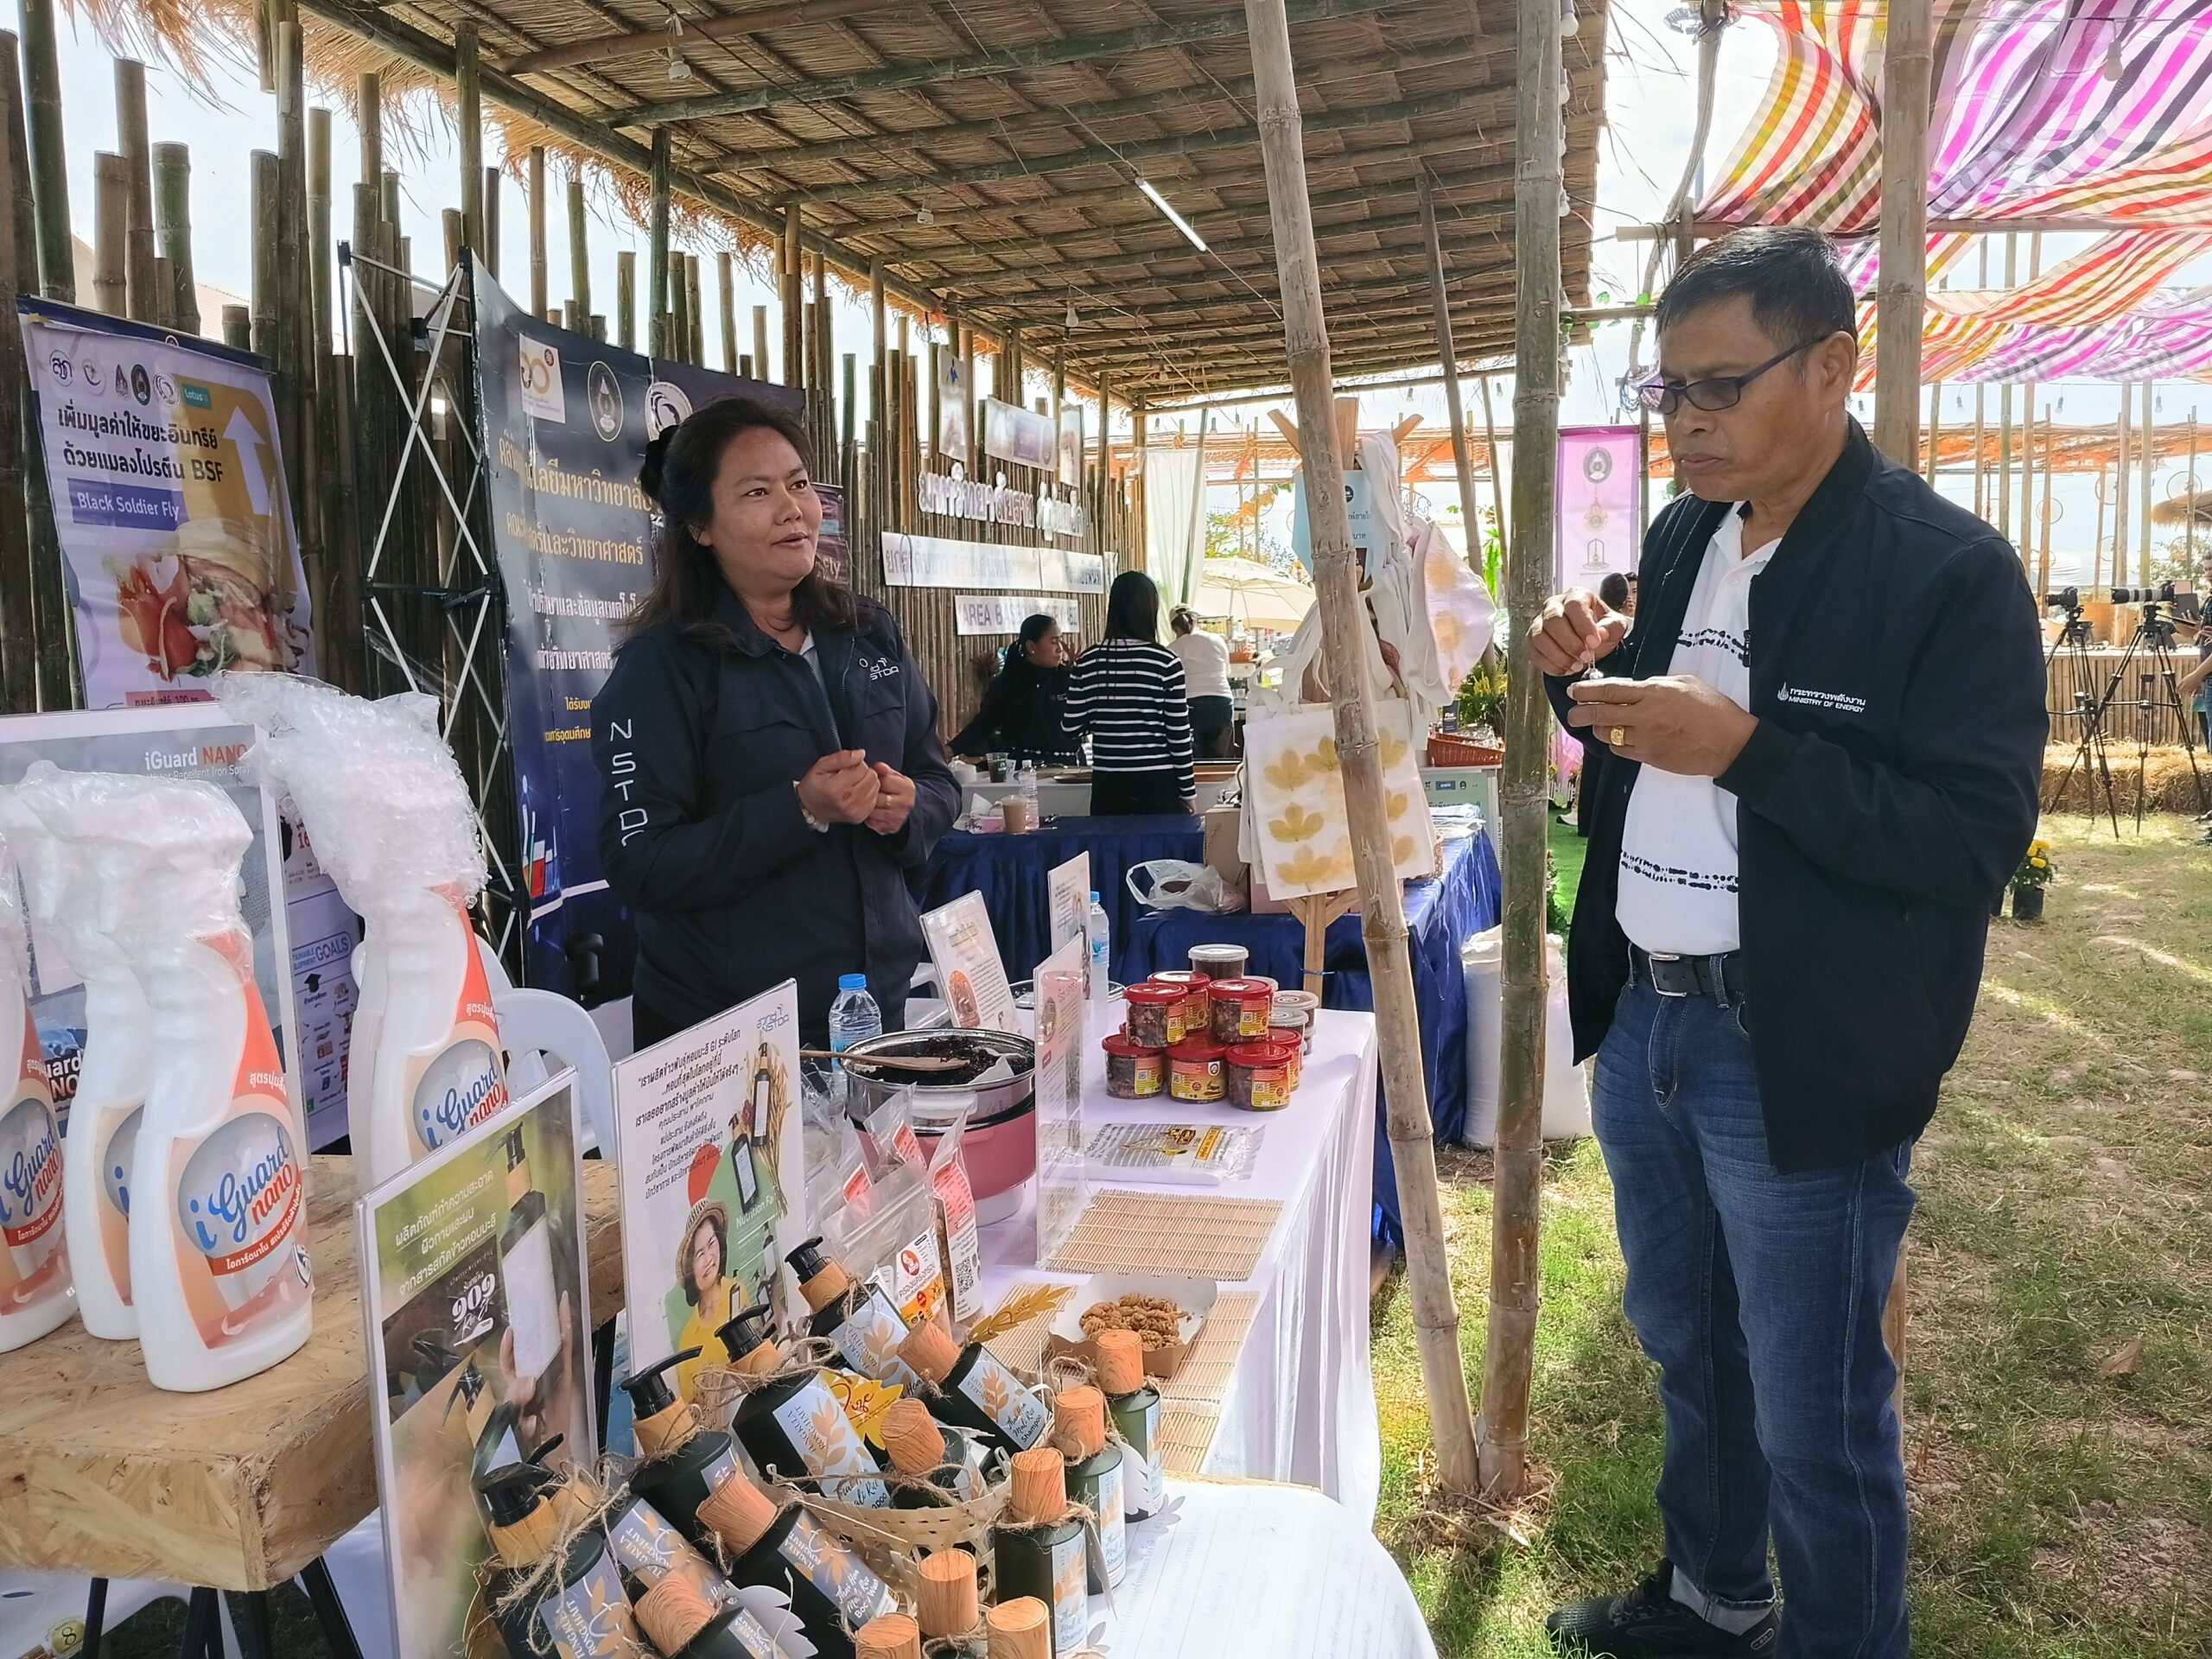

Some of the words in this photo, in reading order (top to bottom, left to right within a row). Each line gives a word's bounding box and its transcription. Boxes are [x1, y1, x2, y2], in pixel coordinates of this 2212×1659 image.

[58, 401, 219, 450] เพิ่มมูลค่าให้ขยะอินทรีย์
[64, 439, 185, 480] ด้วยแมลงโปรตีน
[193, 459, 224, 483] BSF
[77, 492, 114, 512] Black
[117, 496, 160, 517] Soldier
[162, 503, 180, 522] Fly
[870, 665, 899, 680] STDA
[1788, 696, 1822, 706] MINISTRY
[1835, 702, 1865, 714] ENERGY
[1789, 688, 1866, 706] กระทรวงพลังงาน
[144, 747, 198, 771] iGuard
[202, 742, 249, 766] NANO
[212, 766, 227, 776] Iron
[229, 765, 250, 776] Spray
[316, 935, 349, 961] GOALS
[436, 1064, 499, 1136] Guard
[469, 1083, 501, 1127] nano
[4, 1113, 56, 1217] Guard
[35, 1148, 60, 1202] nano
[207, 1126, 289, 1243] Guard
[251, 1163, 293, 1226] nano
[396, 1170, 494, 1247] ผลิตภัณฑ์ทำความสะอาด
[736, 1200, 765, 1229] Nutrition
[421, 1206, 474, 1255] ผิวกายและผม
[226, 1242, 269, 1271] ไอการ์ดนาโน
[399, 1212, 497, 1296] จากสารสกัดข้าวหอมมะลิ
[787, 1410, 817, 1453] TUNGKULA
[1021, 1414, 1042, 1443] Shampoo
[785, 1538, 815, 1571] TUNGKULA
